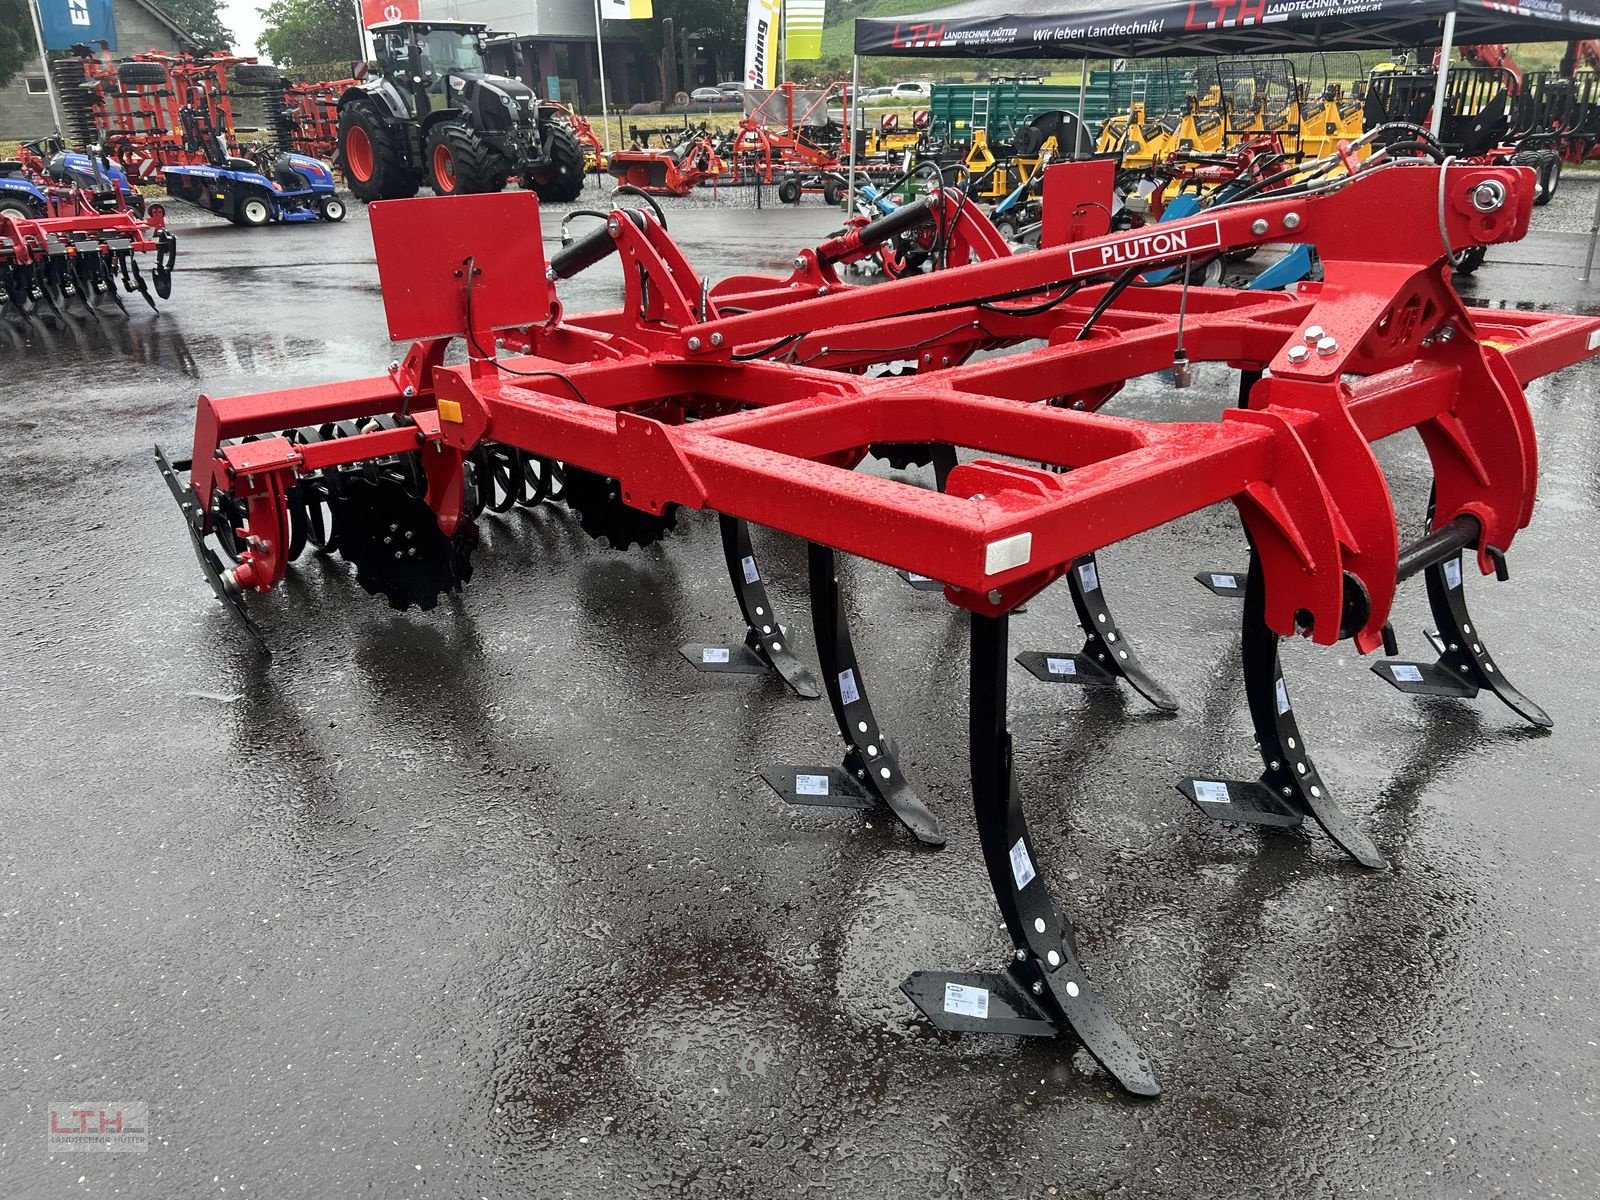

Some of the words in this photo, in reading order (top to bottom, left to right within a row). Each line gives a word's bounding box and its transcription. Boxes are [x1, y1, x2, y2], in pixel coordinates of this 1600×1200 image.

[1301, 3, 1383, 19] www.lt-huetter.at
[891, 23, 946, 48] LTH
[944, 29, 991, 40] LANDTECHNIK
[991, 26, 1018, 37] HÜTTER
[1033, 29, 1052, 41] Wir
[1054, 26, 1085, 40] leben
[1088, 18, 1165, 38] Landtechnik!
[1101, 230, 1188, 265] PLUTON
